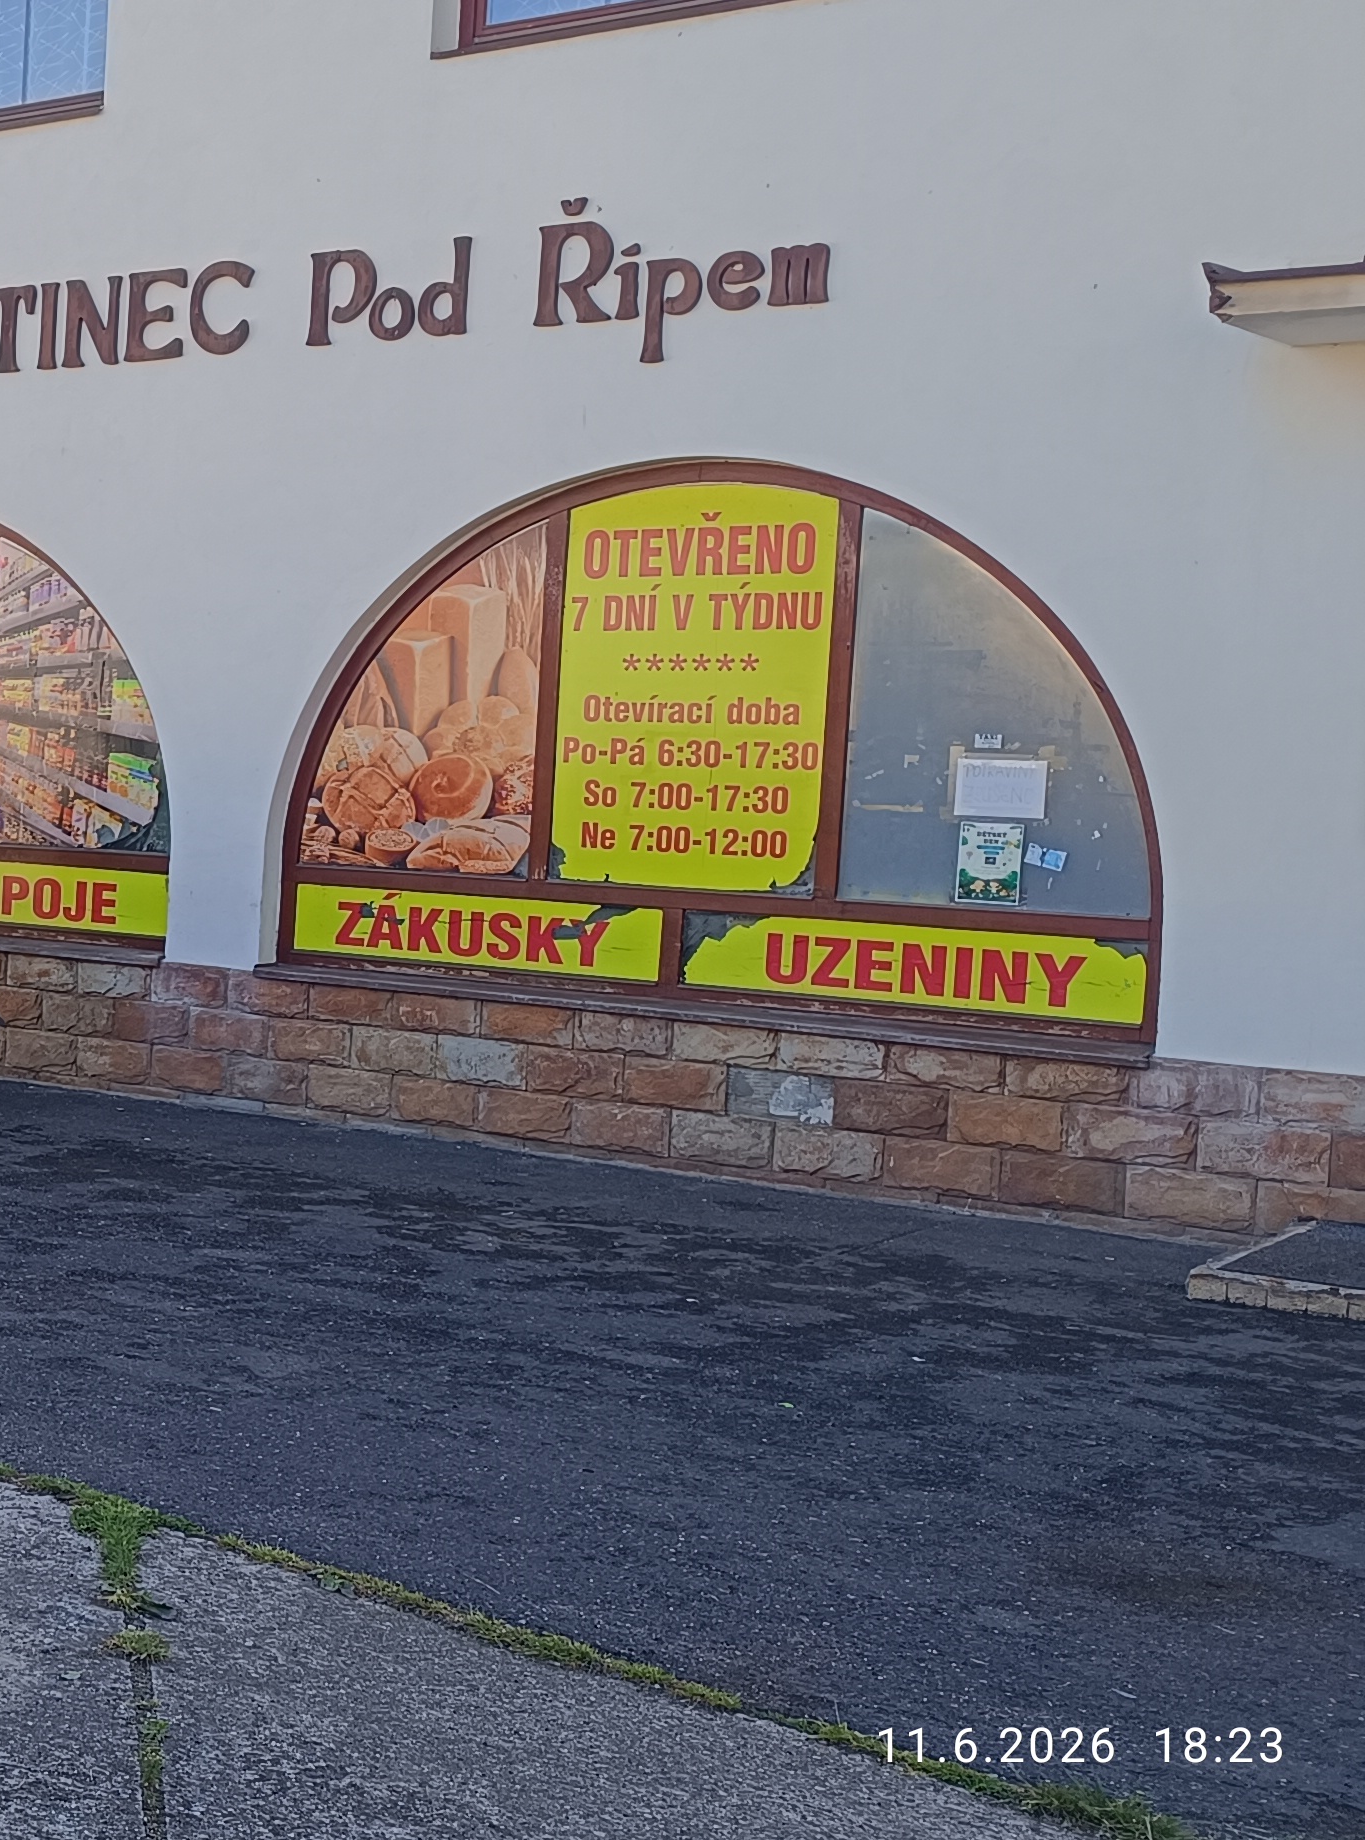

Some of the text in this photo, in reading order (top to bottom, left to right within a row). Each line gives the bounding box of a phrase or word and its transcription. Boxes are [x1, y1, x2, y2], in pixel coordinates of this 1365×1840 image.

[306, 235, 473, 347] Pod
[531, 196, 831, 364] Řípem
[583, 512, 816, 579] OTEVŘENO
[572, 582, 823, 631] 7 DNÍ V TÝDNU
[583, 695, 800, 725] Otevírací doba
[563, 737, 818, 770] Po-Pá 6:30-17:30
[584, 779, 789, 814] So 7:00-17:30
[581, 822, 787, 858] Ne 7:00-12:00
[335, 892, 611, 967] ZÁKUSKY
[765, 933, 1088, 1007] UZENINY
